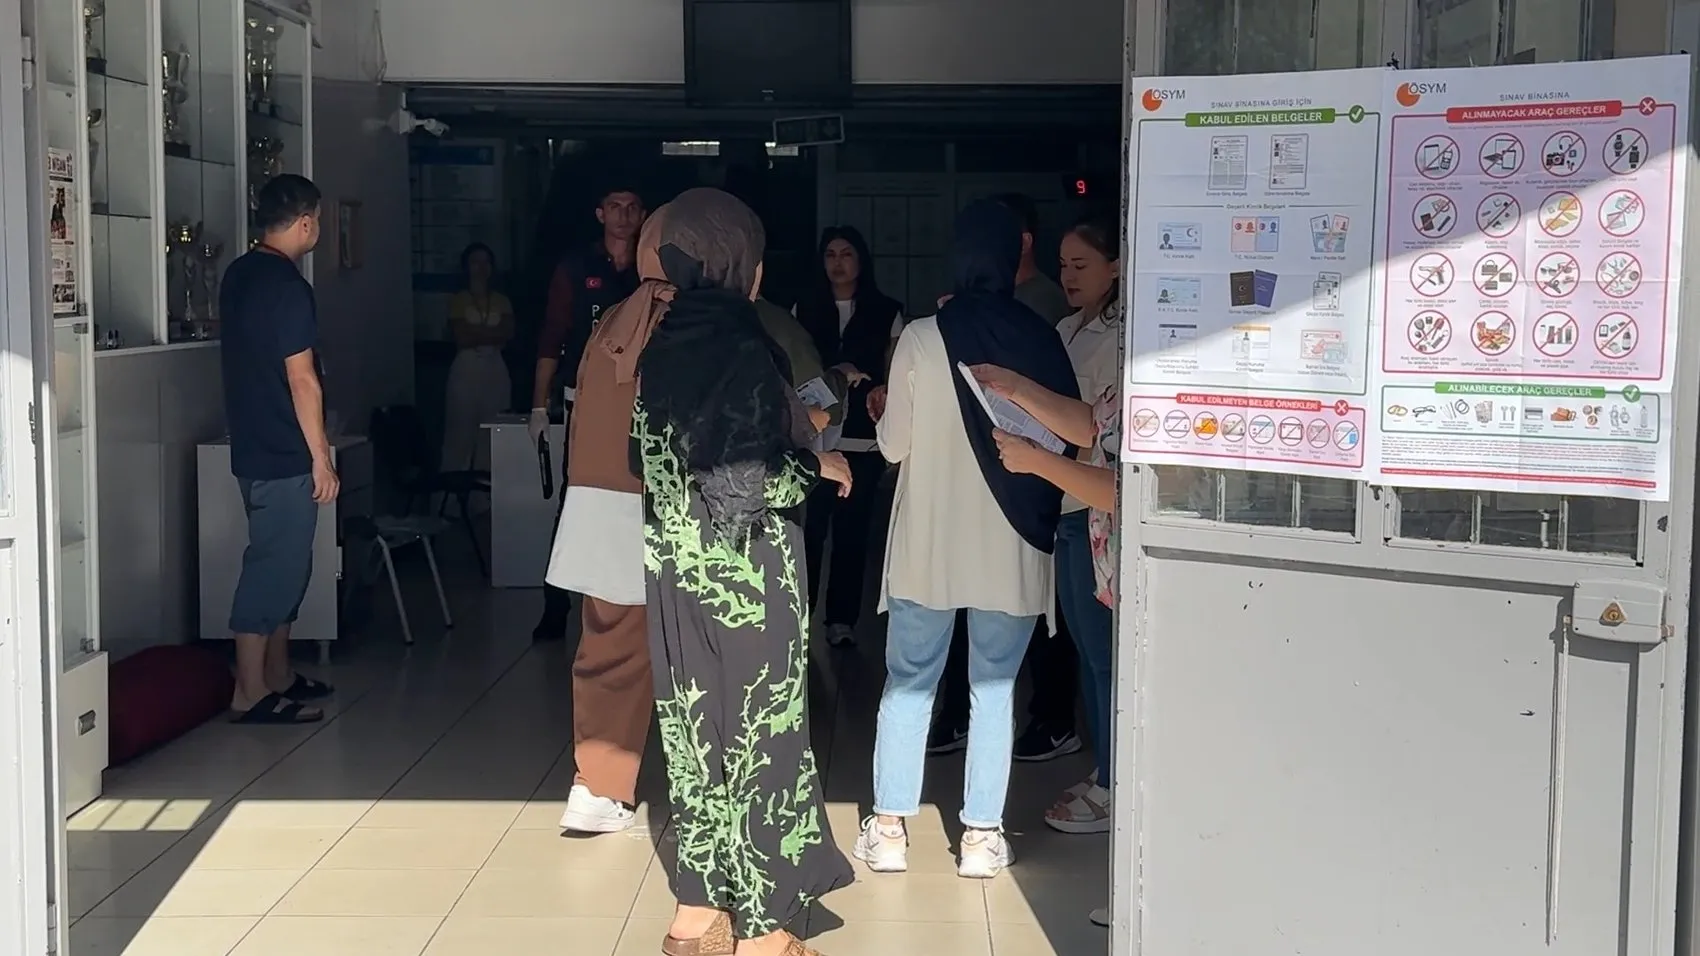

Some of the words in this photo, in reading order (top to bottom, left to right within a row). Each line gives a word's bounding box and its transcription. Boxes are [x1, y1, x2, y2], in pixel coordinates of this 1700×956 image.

[1408, 82, 1447, 95] ÖSYM
[1499, 93, 1525, 102] SINAV
[1199, 114, 1231, 125] KABUL
[1233, 112, 1269, 124] EDİLEN
[1271, 111, 1322, 123] BELGELER
[1462, 109, 1527, 120] ALINMAYACAK
[1527, 107, 1553, 119] ARAÇ
[1555, 105, 1606, 116] GEREÇLER
[1076, 180, 1086, 194] 9
[1447, 384, 1515, 394] ALINABİLECEK
[1516, 385, 1542, 395] ARAÇ
[1543, 386, 1592, 397] GEREÇLER
[1180, 395, 1205, 403] KABUL
[1206, 395, 1248, 406] EDİLMEYEN
[1249, 398, 1275, 408] BELGE
[1275, 399, 1318, 410] ÖRNEKLERİ
